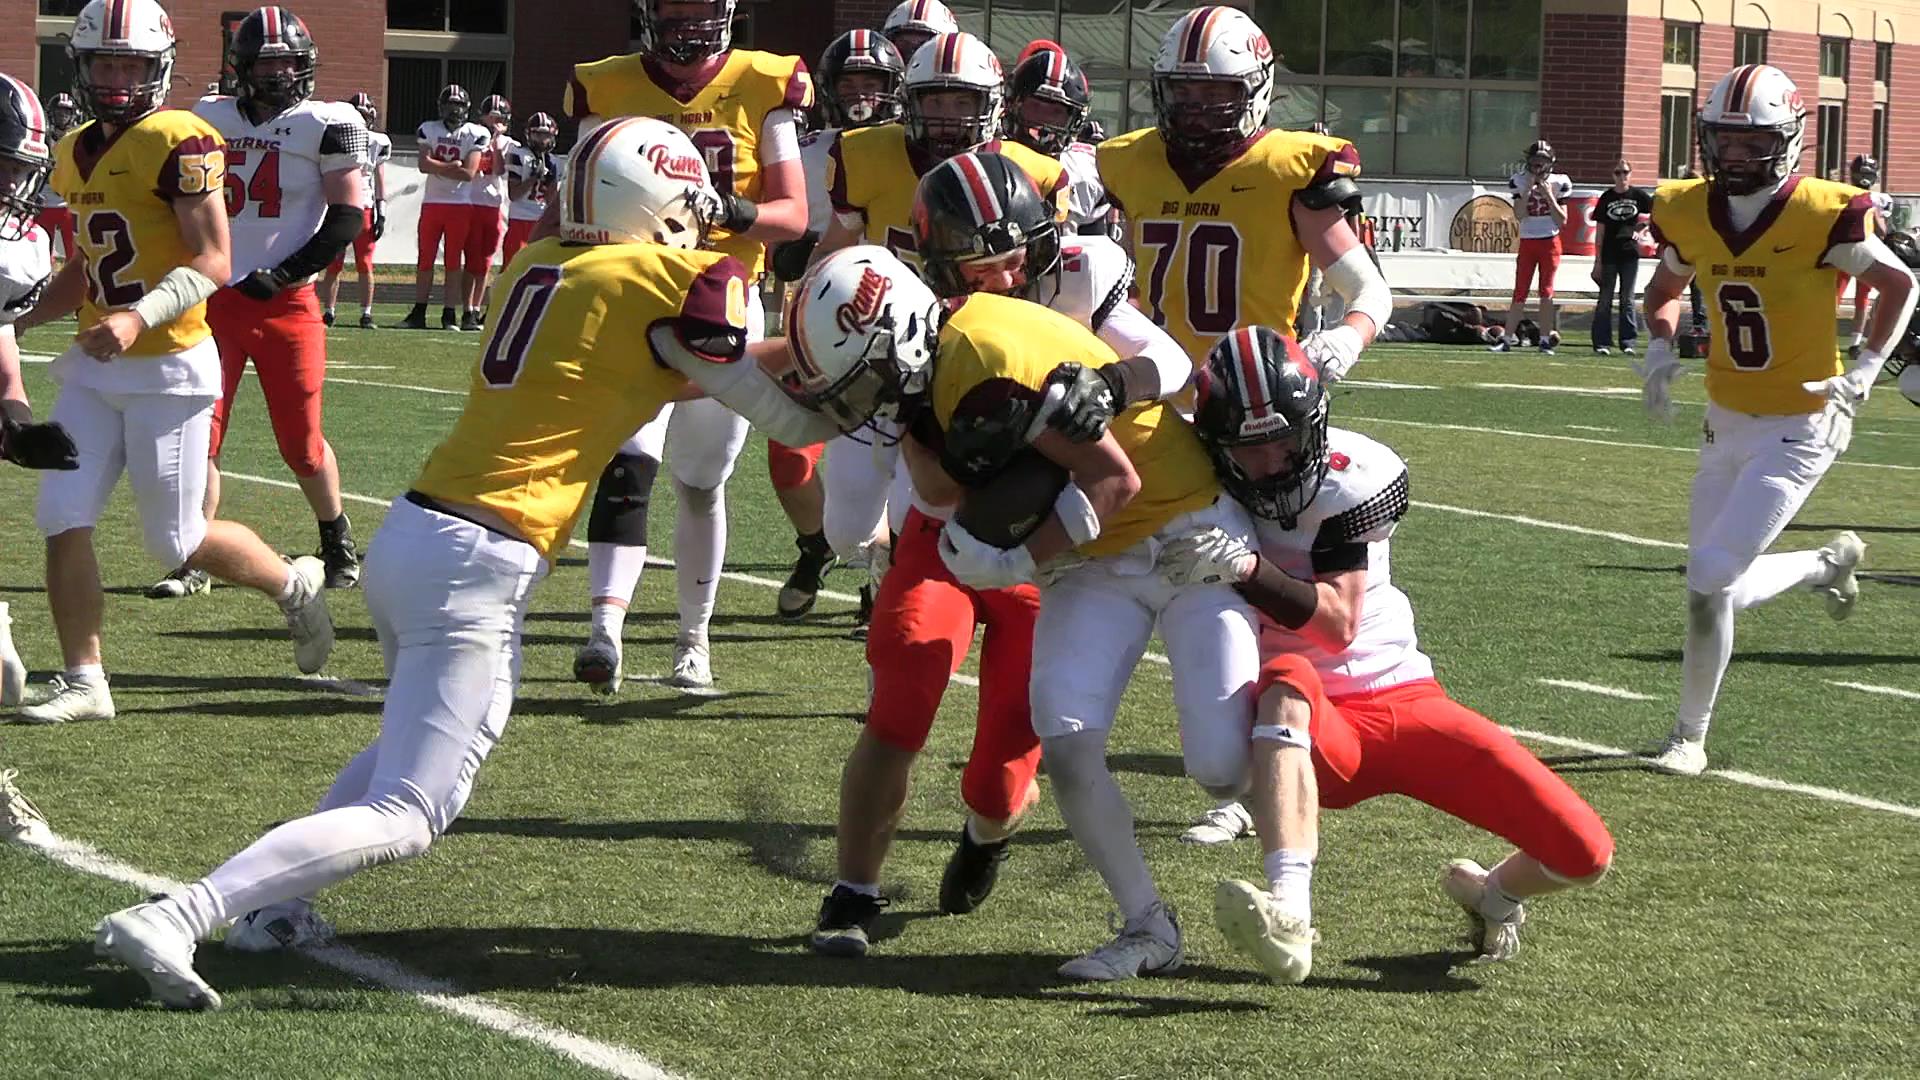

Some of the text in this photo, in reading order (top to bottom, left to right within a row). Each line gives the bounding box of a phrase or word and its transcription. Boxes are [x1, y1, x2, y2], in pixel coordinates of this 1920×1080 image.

[680, 111, 713, 124] HORN
[178, 149, 225, 195] 52
[647, 144, 705, 188] Rams
[1161, 201, 1220, 217] BIG HORN
[1139, 219, 1243, 336] 70
[480, 264, 563, 389] 0
[1716, 280, 1773, 371] 6
